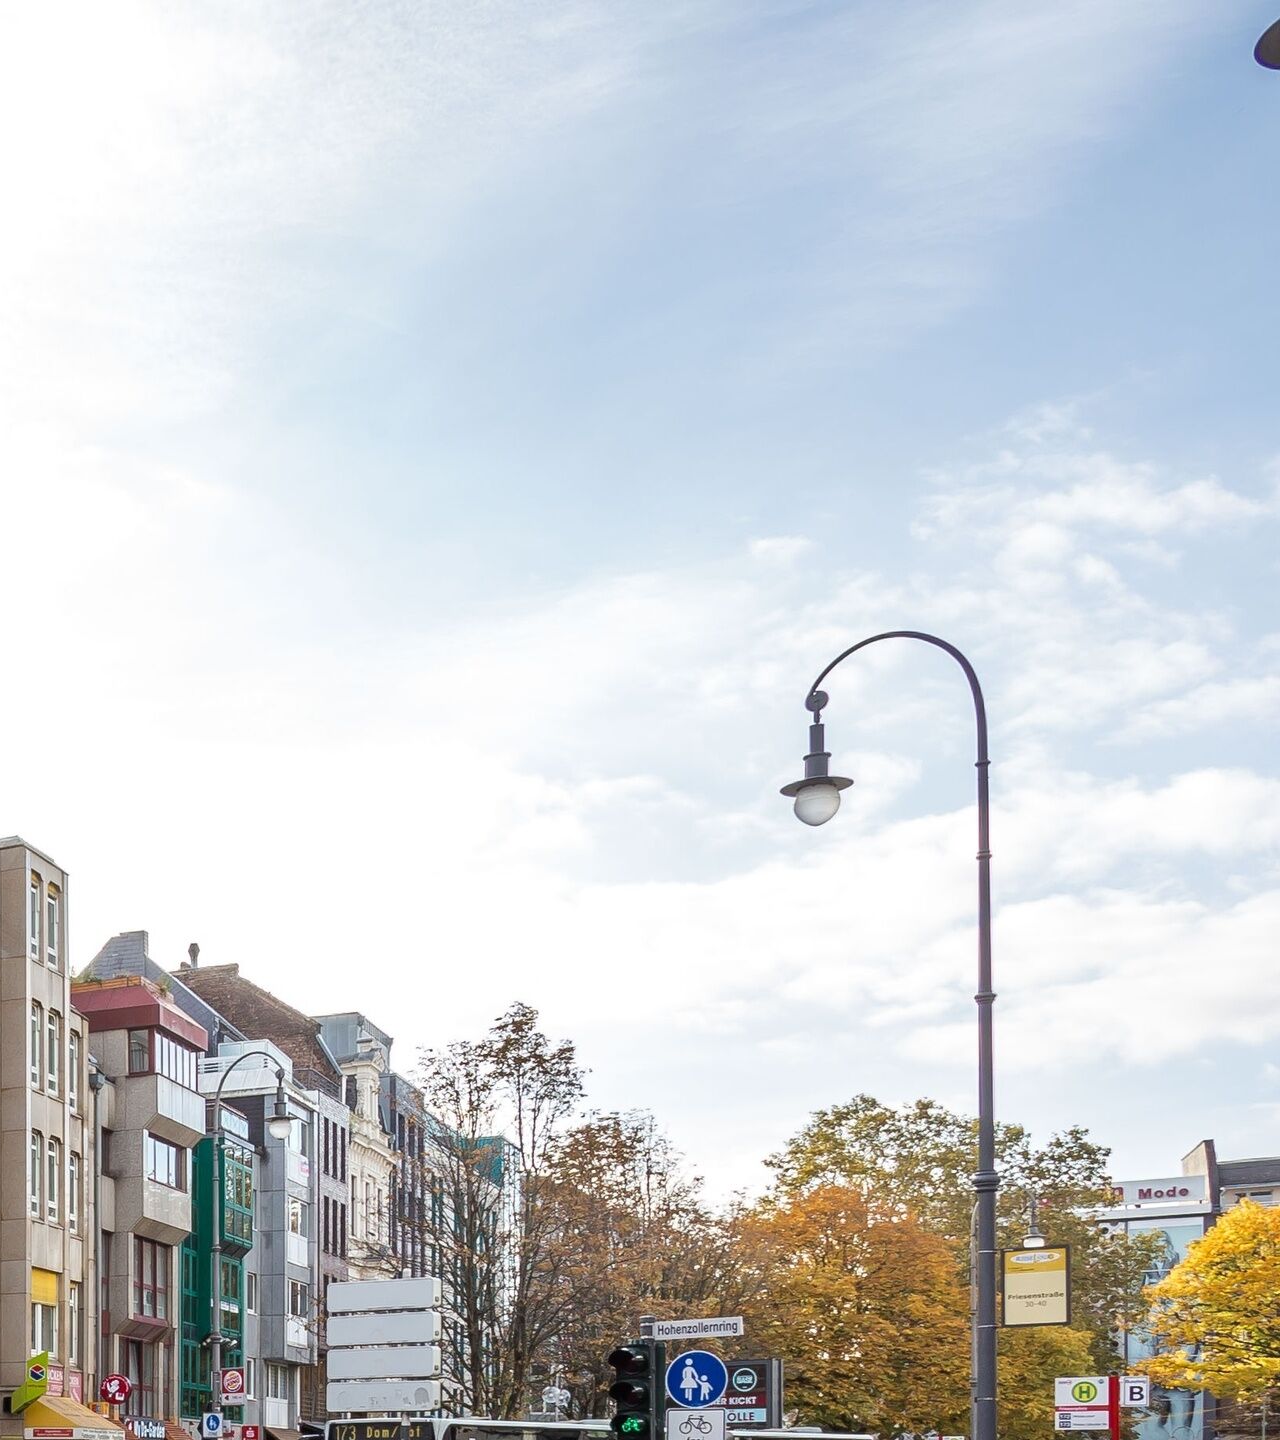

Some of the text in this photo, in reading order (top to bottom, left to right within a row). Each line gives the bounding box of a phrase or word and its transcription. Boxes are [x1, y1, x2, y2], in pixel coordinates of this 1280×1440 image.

[1137, 1186, 1189, 1200] Mode
[1007, 1291, 1064, 1300] Friesenstraße
[657, 1321, 738, 1336] Hohenzollernring
[1078, 1385, 1090, 1399] H
[1129, 1386, 1144, 1401] B
[728, 1396, 757, 1405] KICKT
